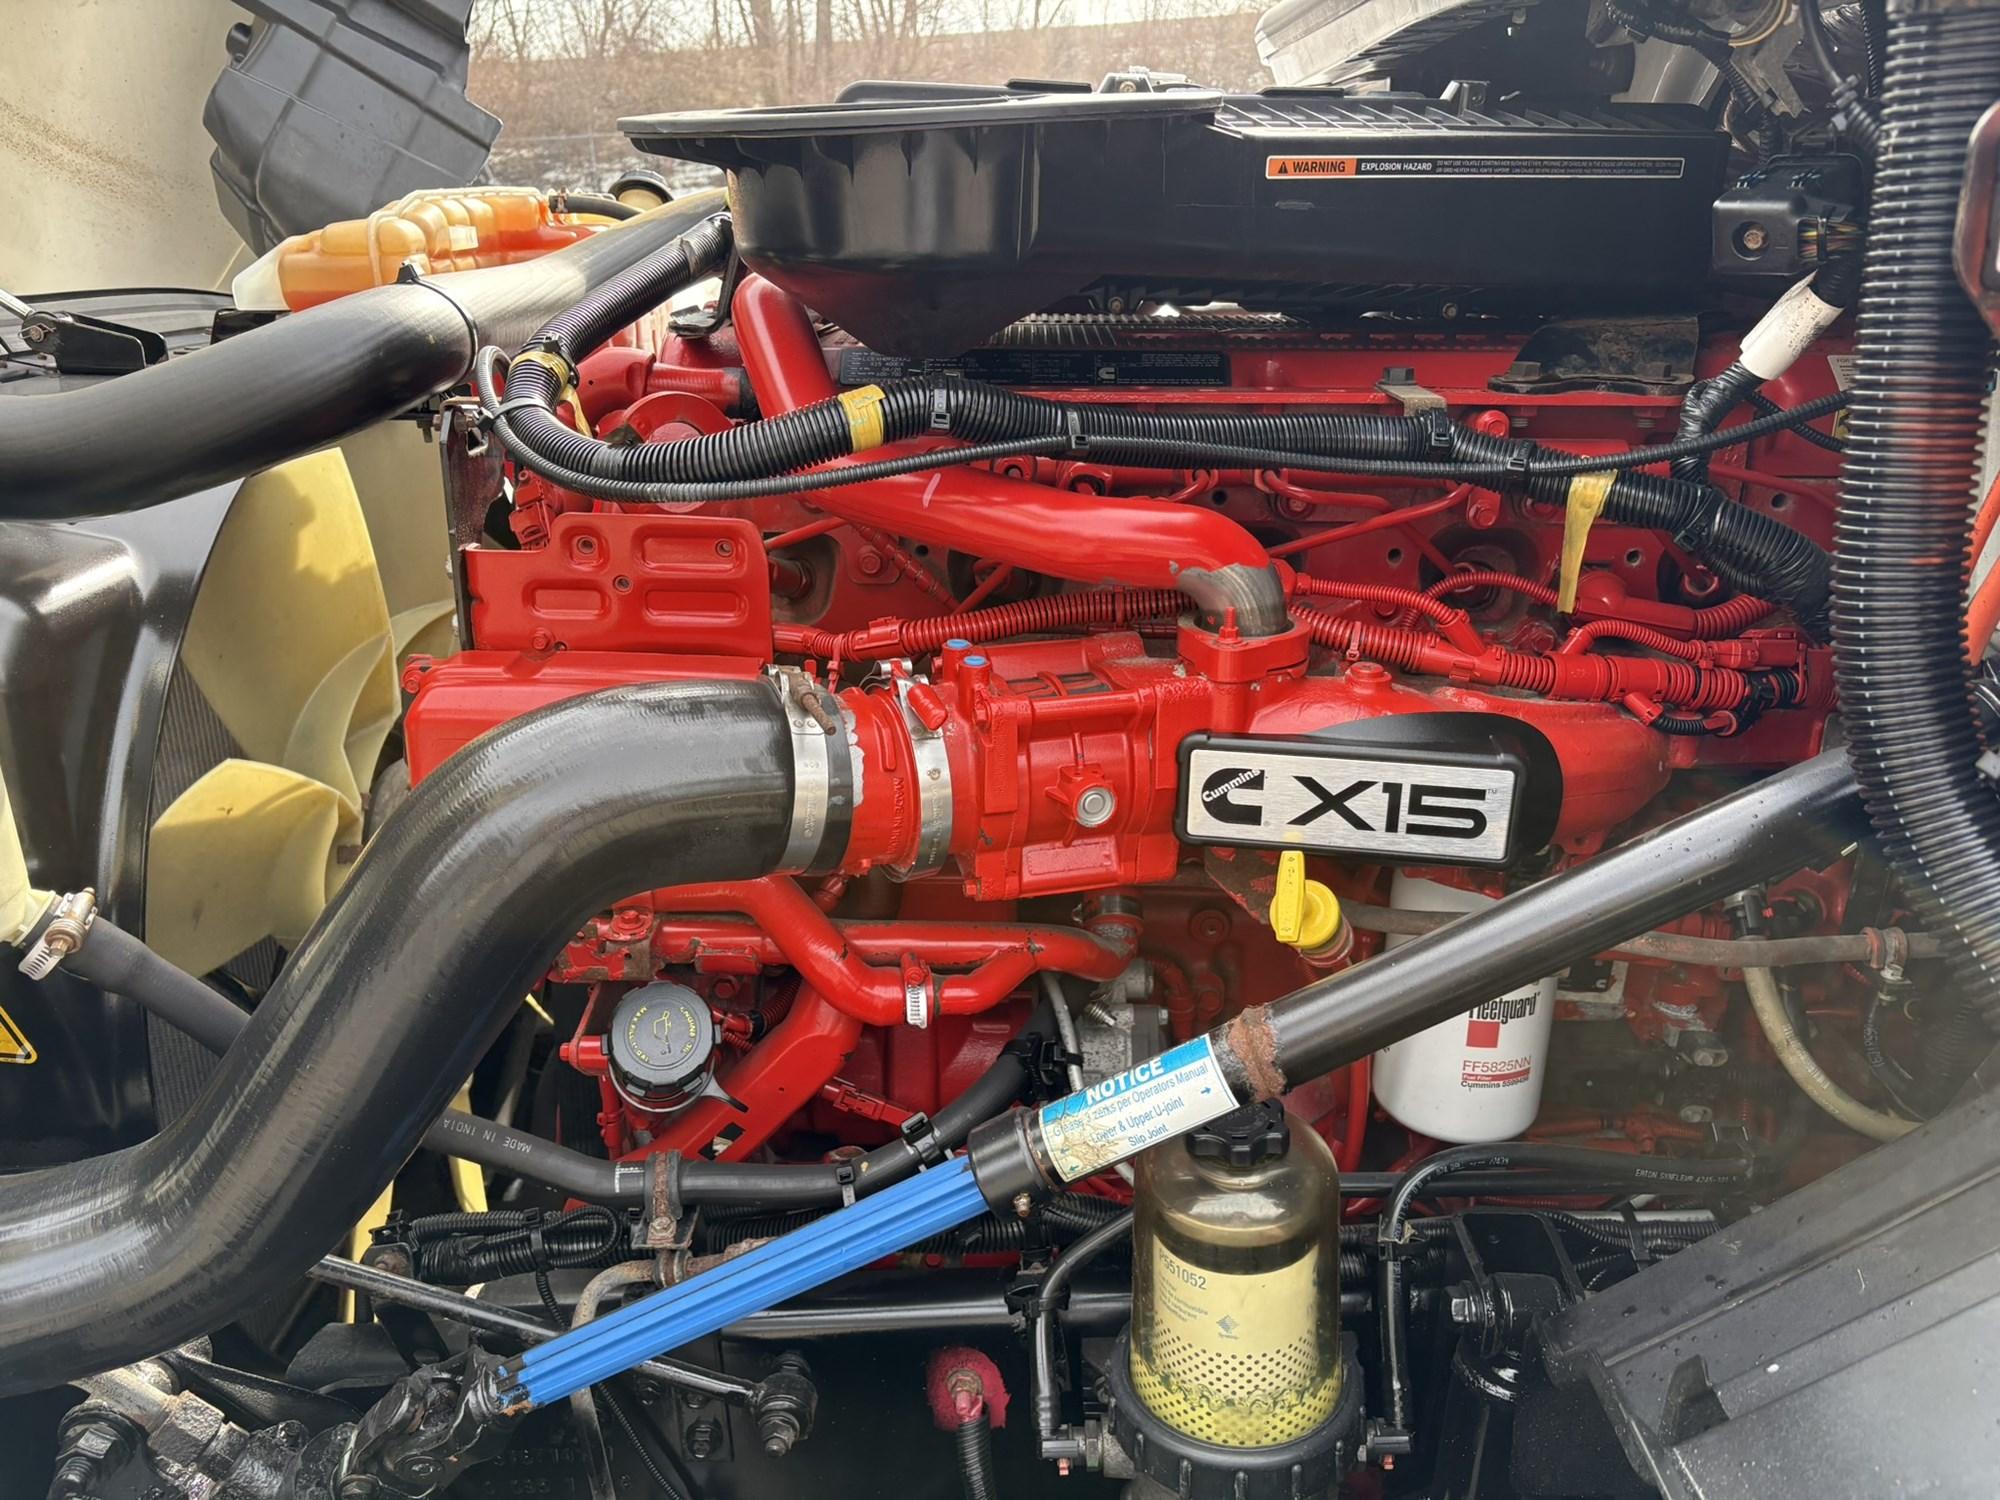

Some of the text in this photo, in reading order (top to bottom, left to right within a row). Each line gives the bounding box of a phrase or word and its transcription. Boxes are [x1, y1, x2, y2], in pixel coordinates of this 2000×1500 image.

[1293, 161, 1346, 173] WARNING
[1361, 162, 1432, 172] EXPLOSION HAZARD
[893, 777, 905, 816] MADE
[1202, 769, 1261, 802] Cummins
[1287, 775, 1487, 839] X15
[679, 1006, 697, 1038] ENGINE
[1462, 1055, 1531, 1073] FF5825NN
[1086, 1058, 1165, 1106] NOTICE
[1117, 1096, 1132, 1113] per
[1134, 1078, 1176, 1103] Operators
[1176, 1062, 1209, 1085] Manual
[1461, 1080, 1500, 1089] Cummins
[1119, 1119, 1127, 1132] &
[1127, 1111, 1156, 1130] Upper
[1155, 1096, 1185, 1118] U-joint
[442, 1117, 532, 1154] MADE IN INDIA
[1128, 1123, 1169, 1148] Slip Joint
